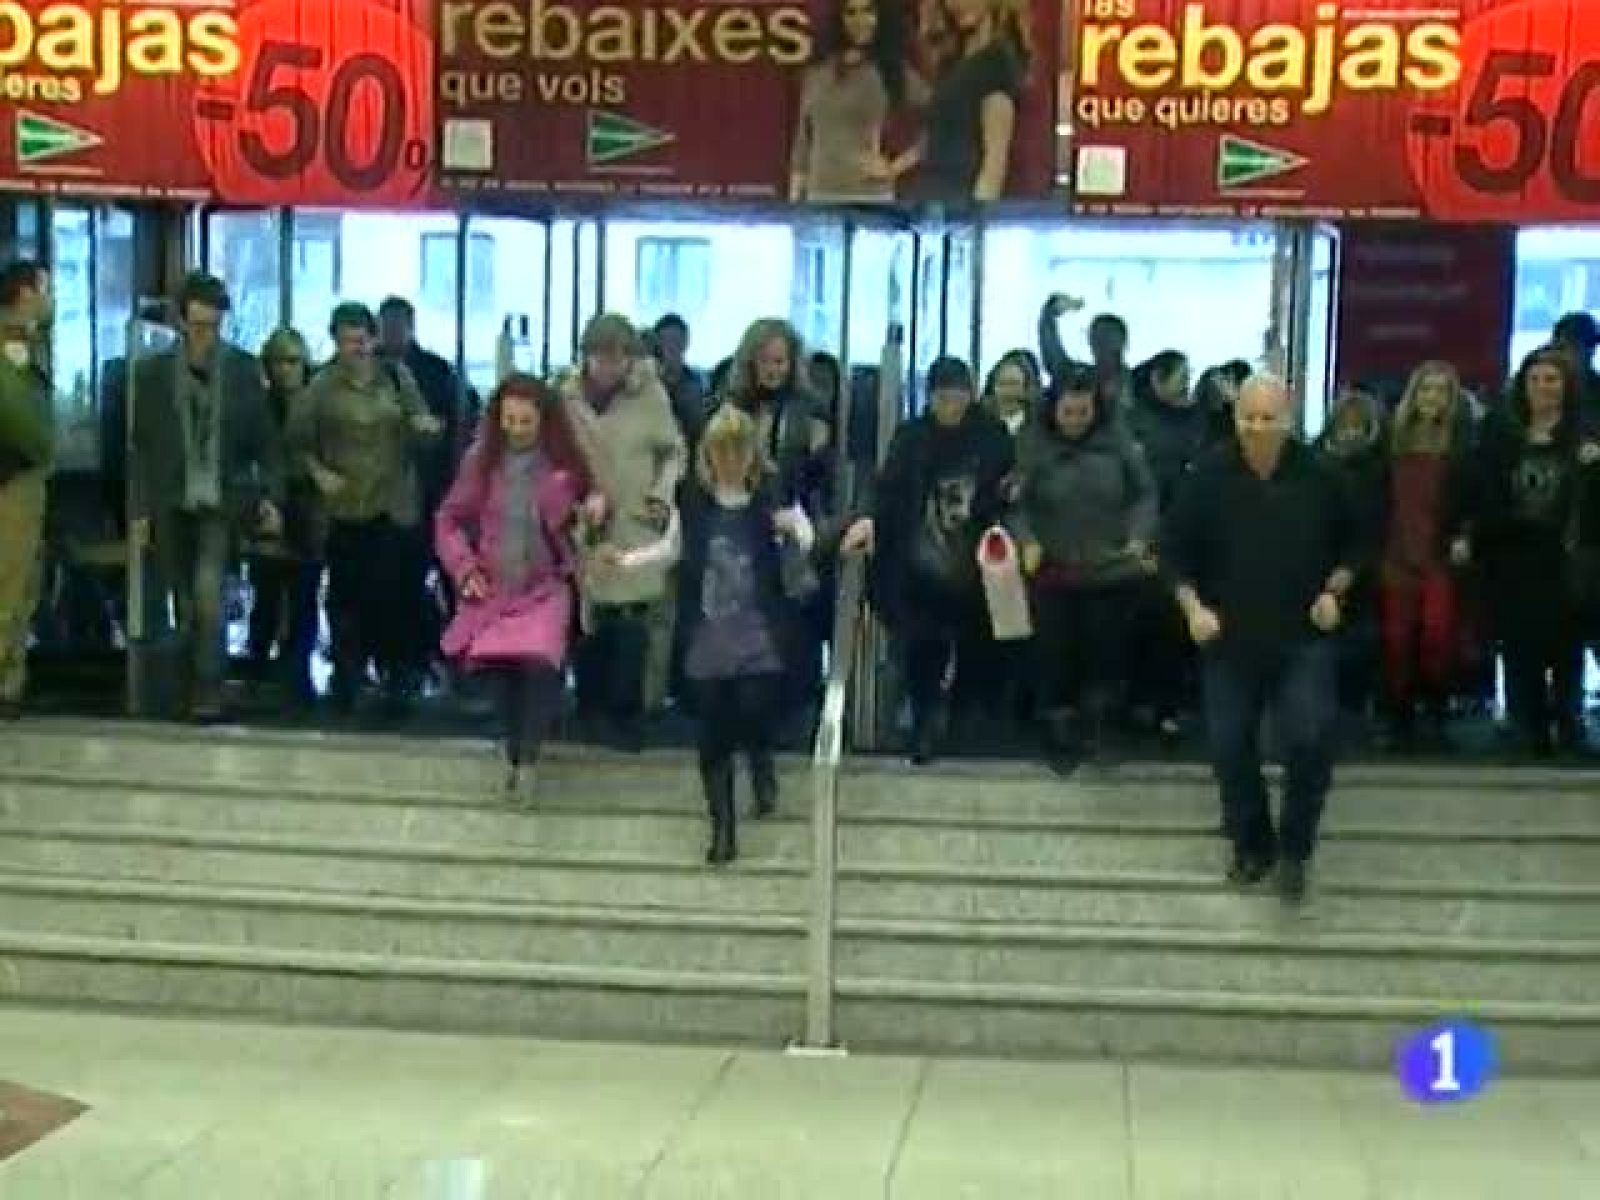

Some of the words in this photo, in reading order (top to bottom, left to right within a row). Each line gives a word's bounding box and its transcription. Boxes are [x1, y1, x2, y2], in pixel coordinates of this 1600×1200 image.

[441, 0, 812, 63] rebaixes
[1080, 3, 1462, 115] rebajas
[439, 72, 522, 107] que
[537, 69, 626, 104] vols
[1077, 95, 1146, 129] que
[1154, 91, 1290, 130] quieres
